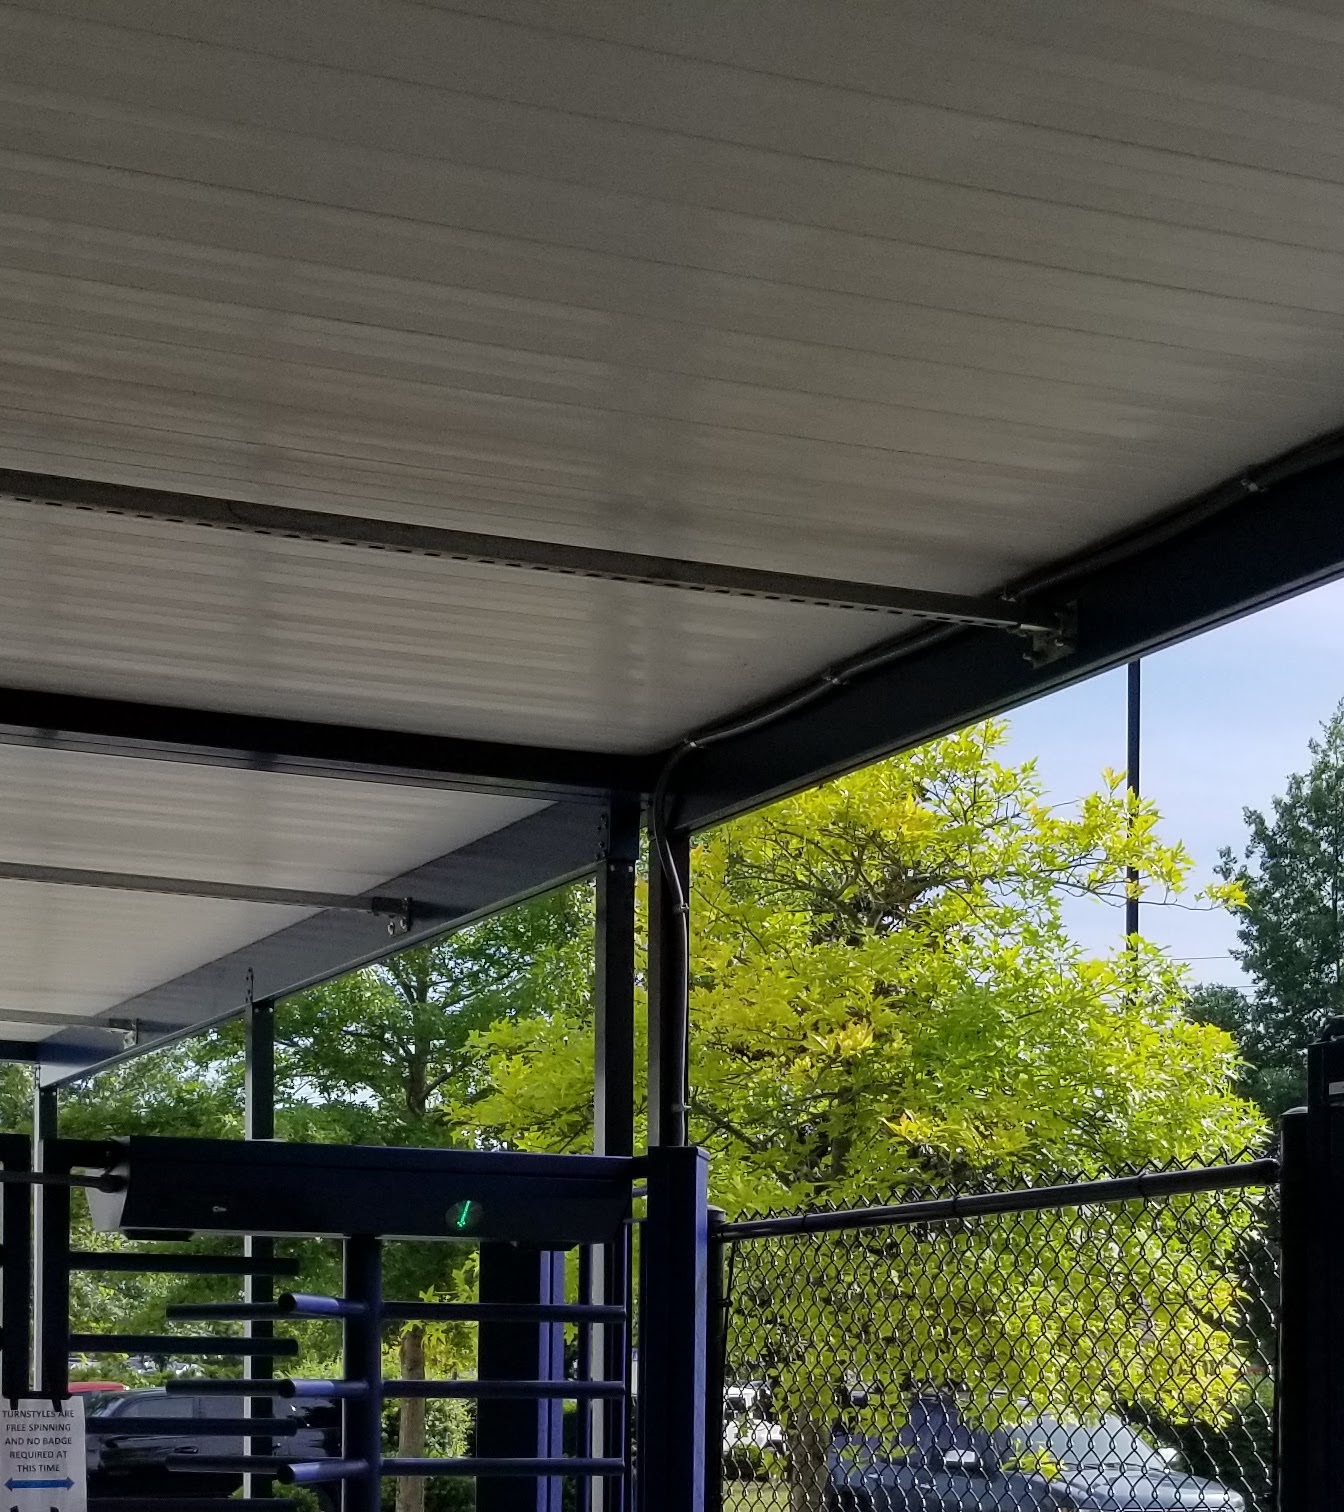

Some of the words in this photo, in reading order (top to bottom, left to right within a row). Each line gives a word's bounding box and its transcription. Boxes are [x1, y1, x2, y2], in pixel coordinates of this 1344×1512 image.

[2, 1410, 56, 1418] TURNSTYLES
[57, 1410, 75, 1418] ARE
[5, 1437, 25, 1445] AND
[27, 1437, 41, 1445] NO
[43, 1437, 72, 1445] BADGE
[10, 1451, 54, 1459] REQUIRED
[17, 1464, 37, 1472] THIS
[39, 1464, 60, 1472] TIME
